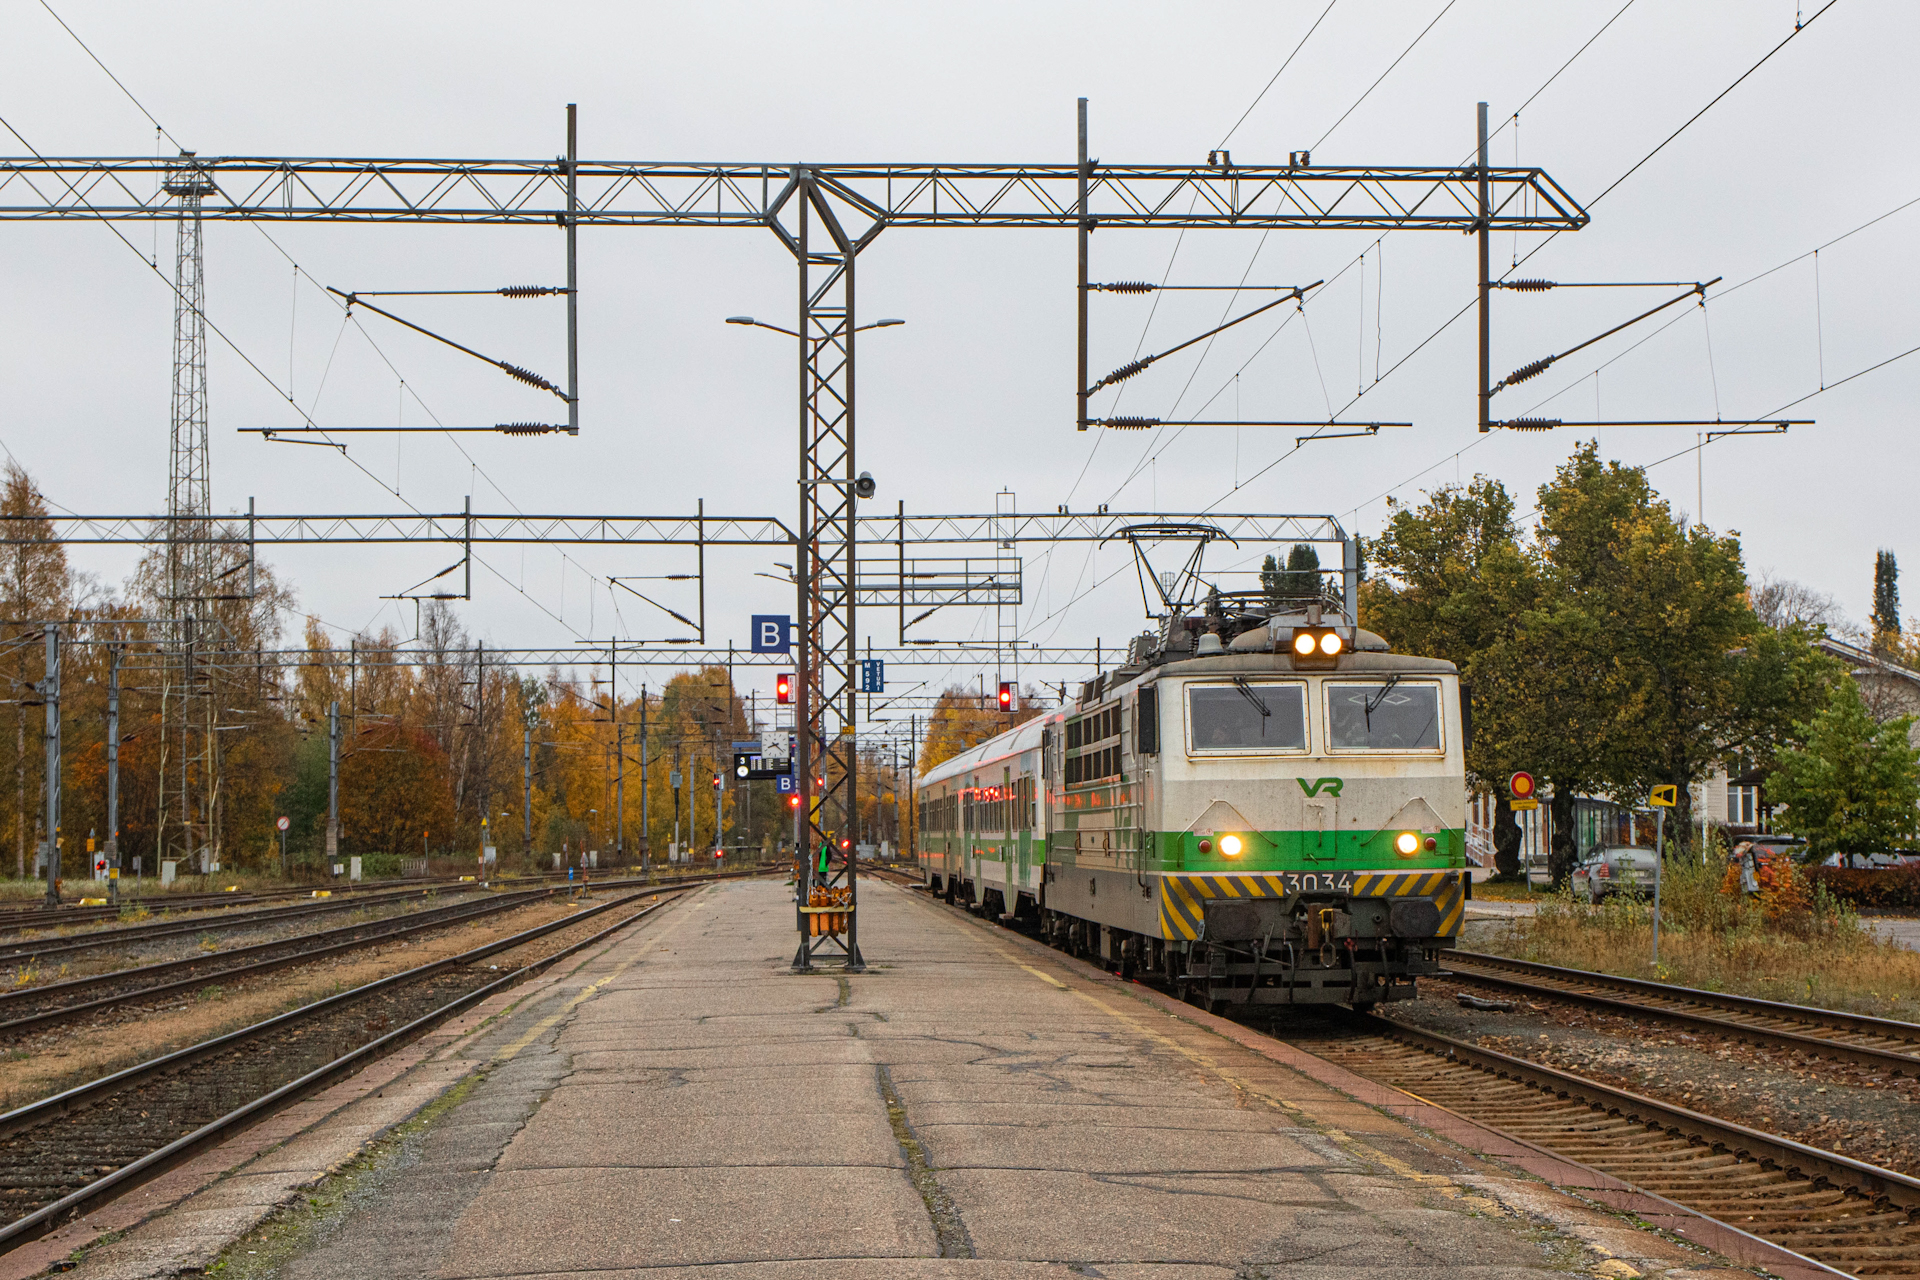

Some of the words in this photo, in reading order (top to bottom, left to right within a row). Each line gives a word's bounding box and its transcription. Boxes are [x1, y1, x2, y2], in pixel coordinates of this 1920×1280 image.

[761, 621, 780, 647] B
[740, 756, 746, 765] 3
[781, 777, 791, 790] B
[1295, 777, 1344, 798] VR
[1285, 873, 1352, 895] 3034
